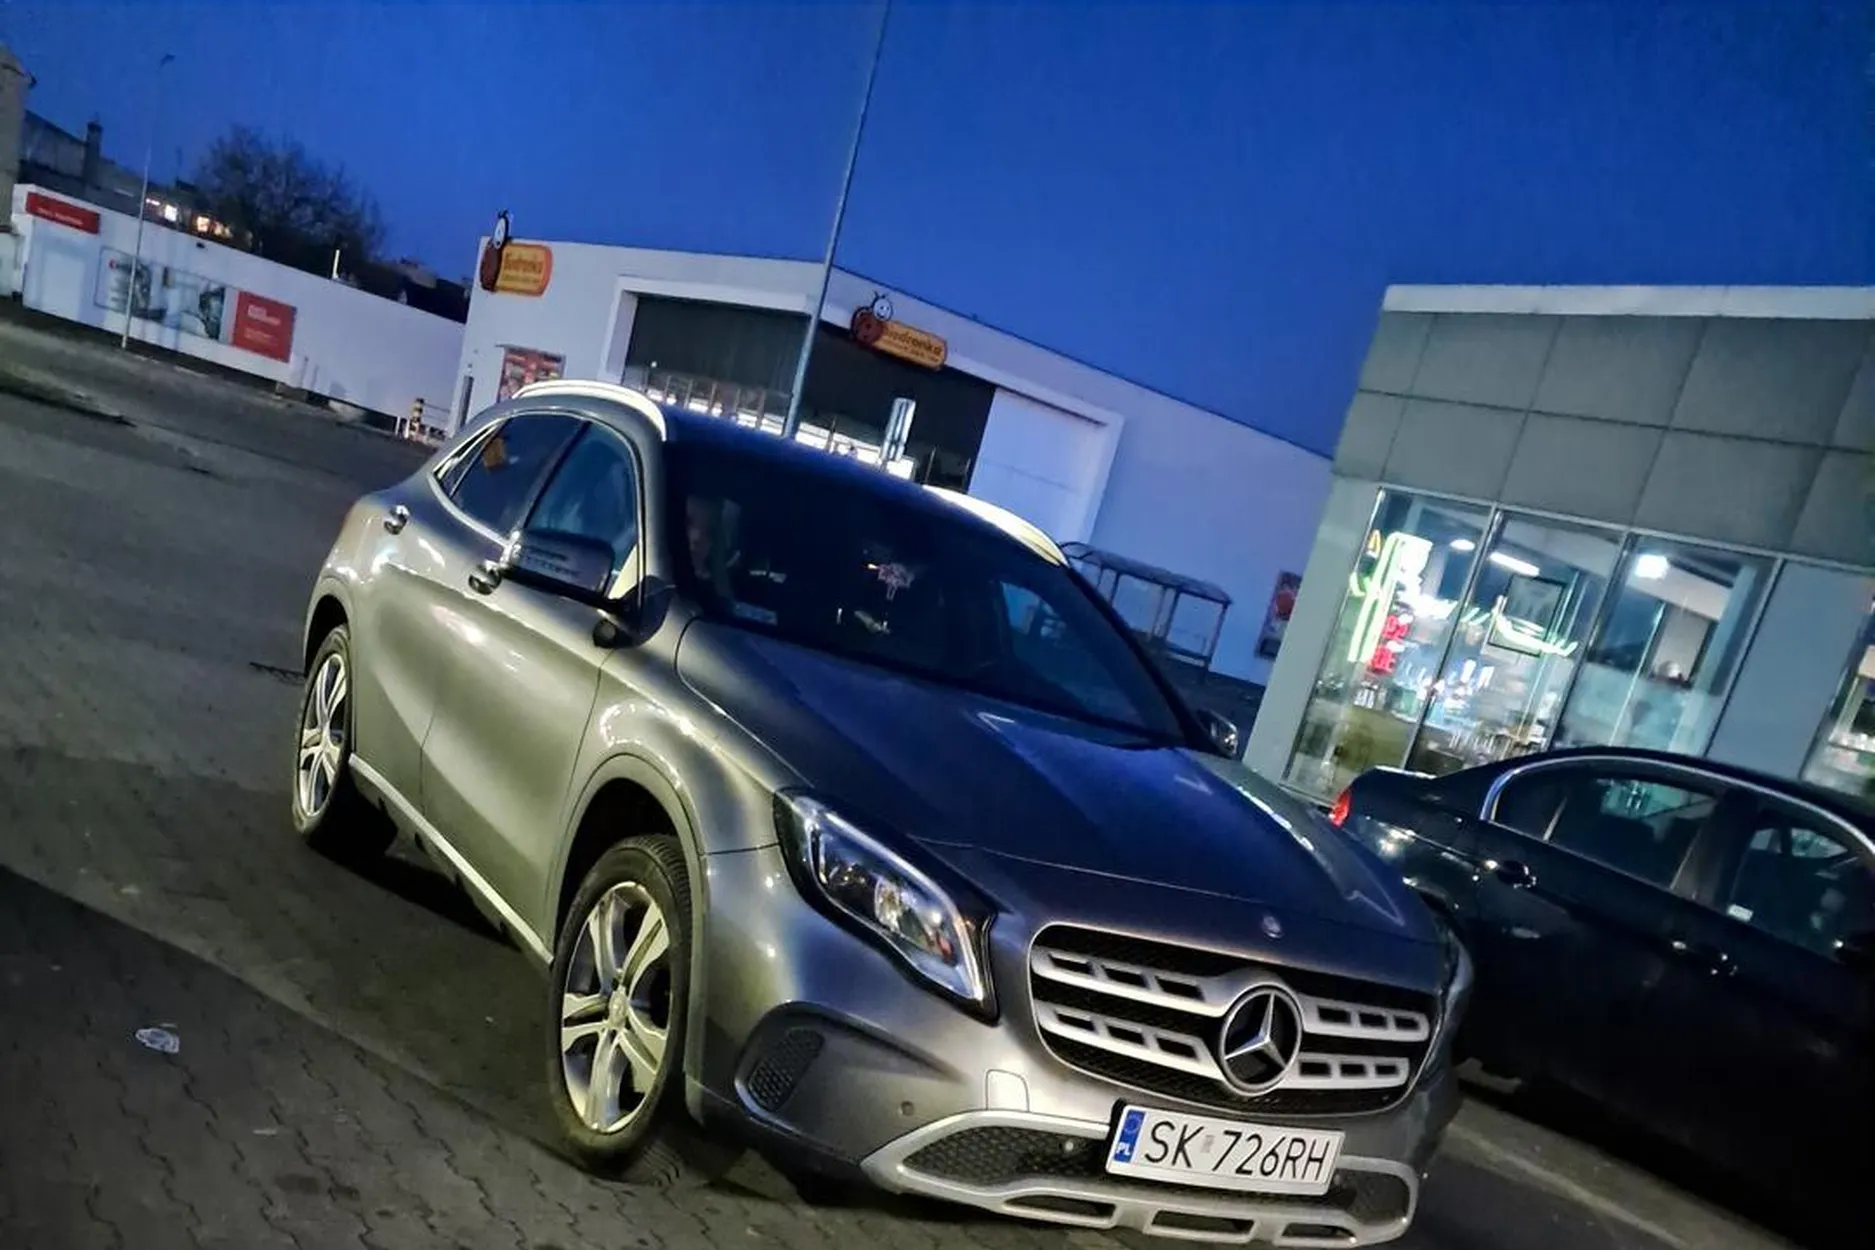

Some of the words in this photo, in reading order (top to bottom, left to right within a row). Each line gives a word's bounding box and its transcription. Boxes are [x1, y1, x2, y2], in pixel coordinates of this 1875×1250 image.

[1116, 1141, 1131, 1156] PL
[1144, 1120, 1204, 1168] SK
[1212, 1130, 1330, 1181] 726RH
